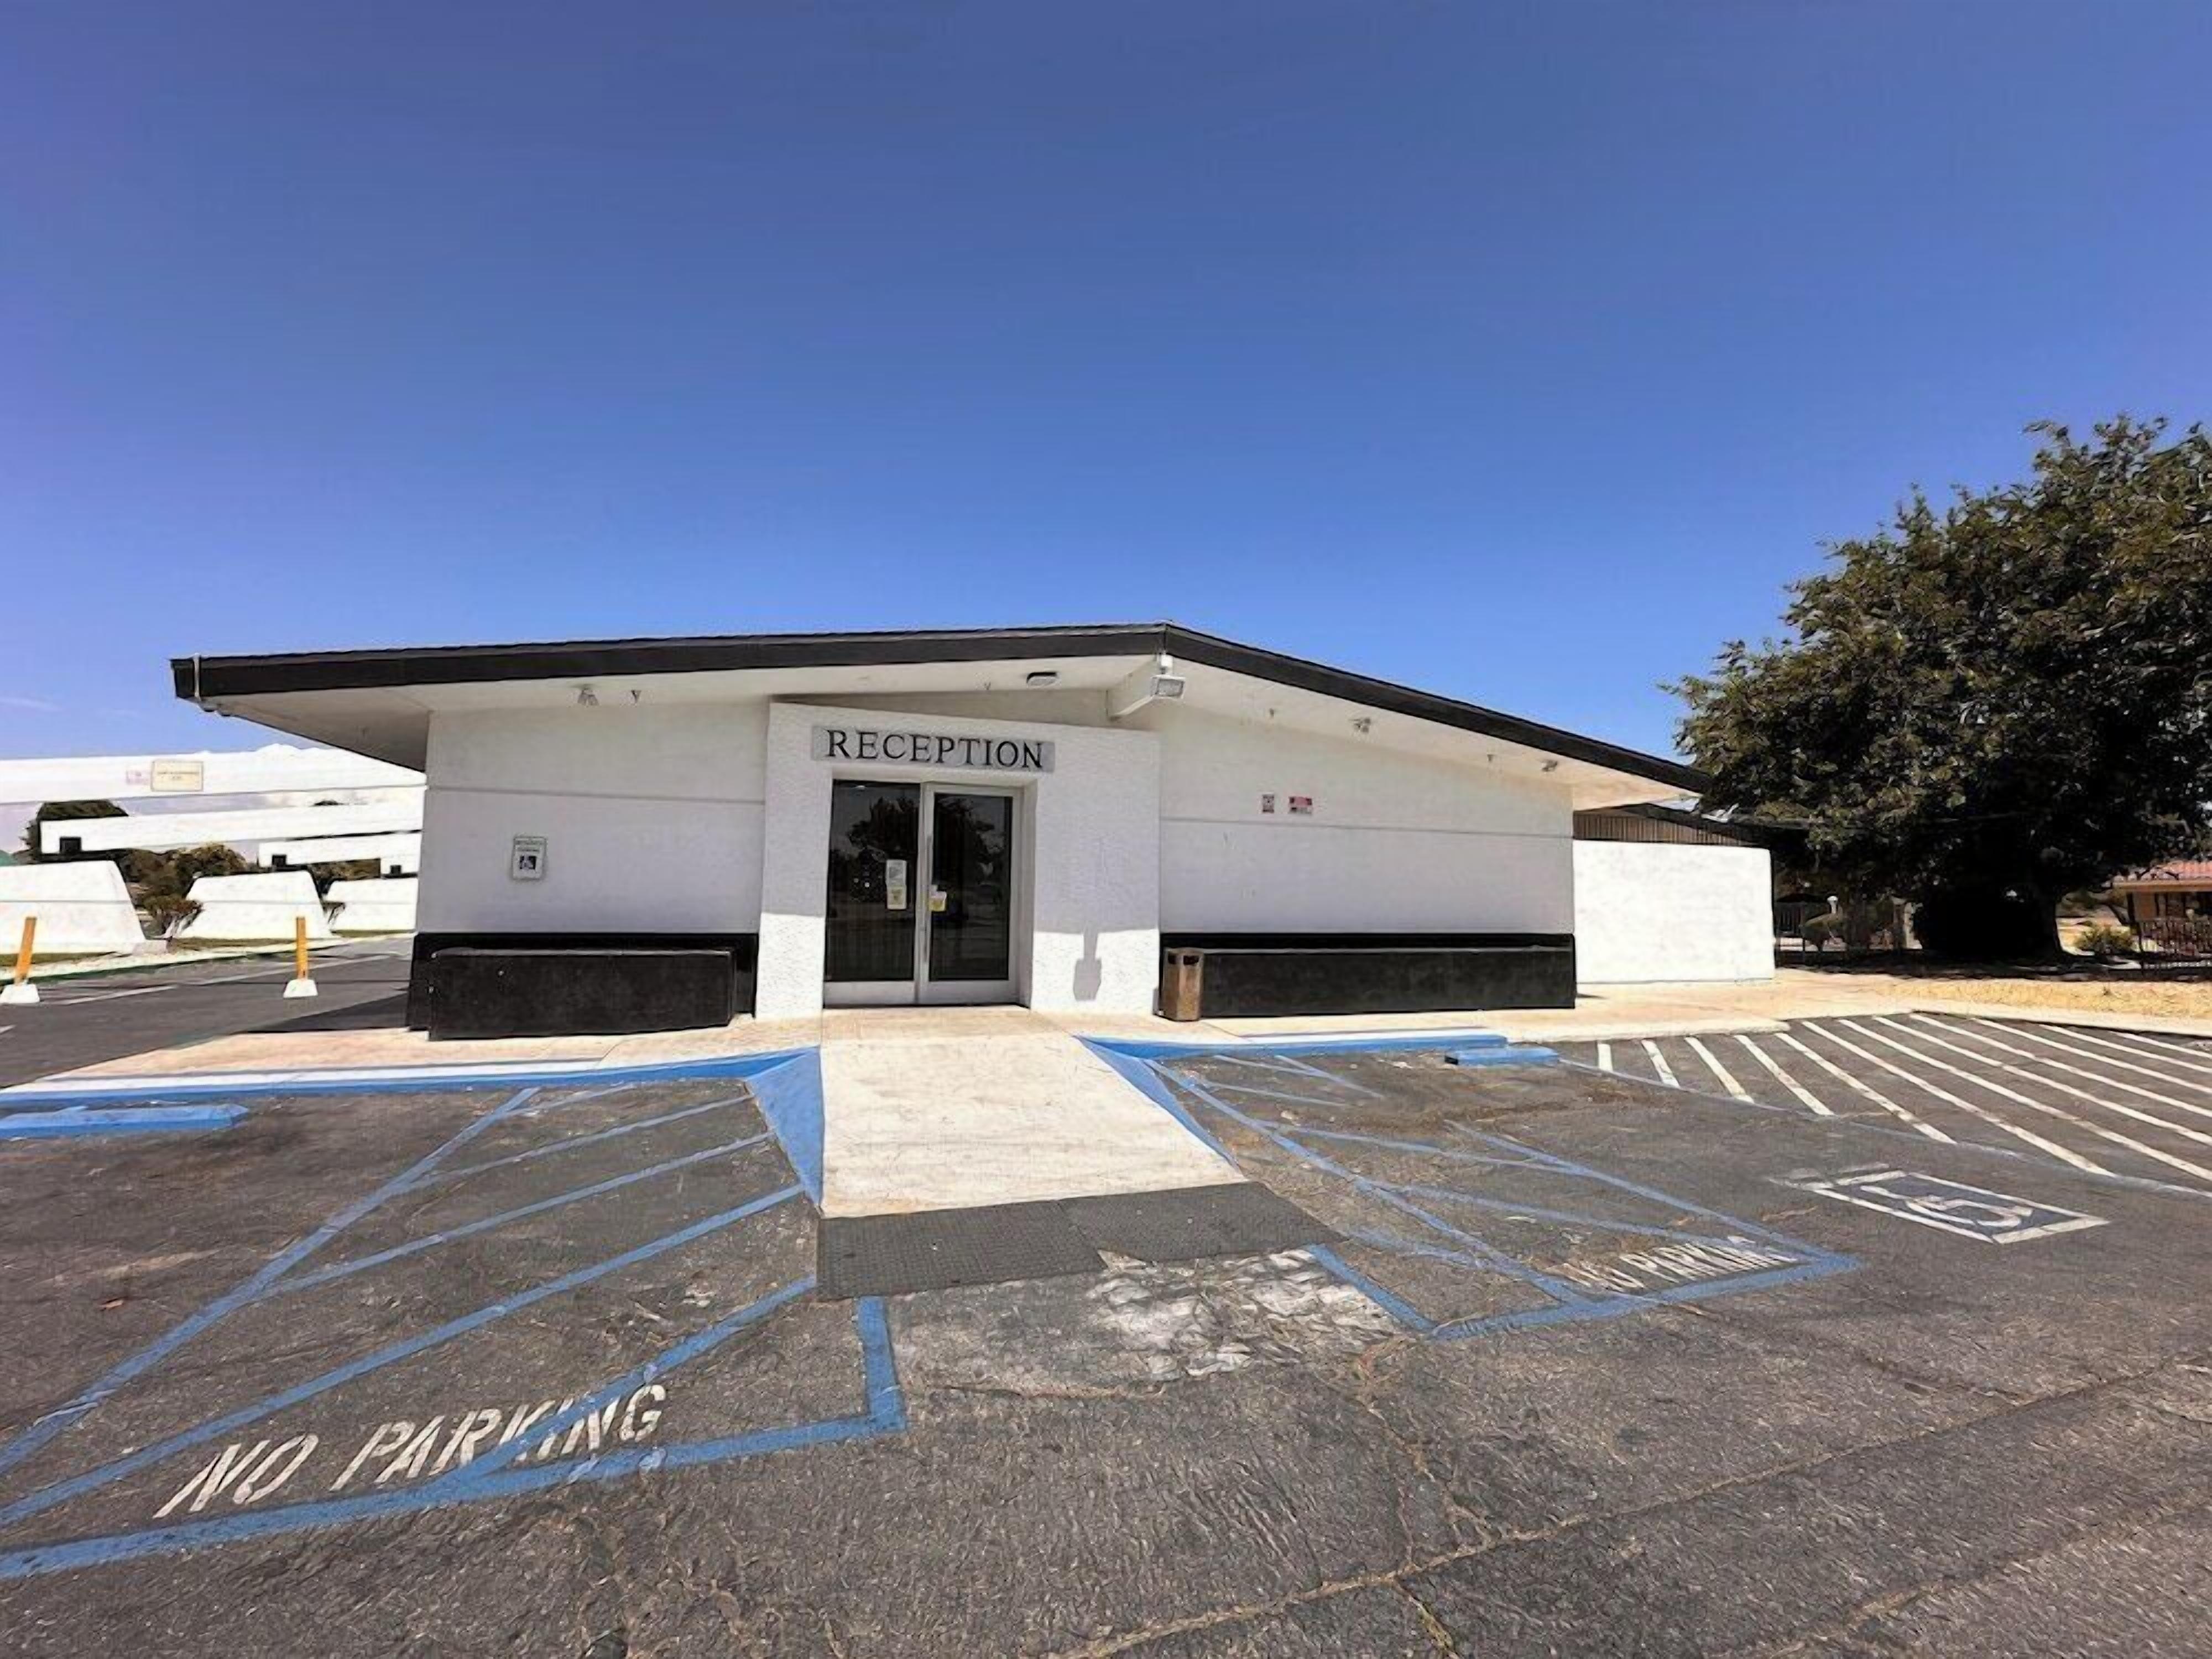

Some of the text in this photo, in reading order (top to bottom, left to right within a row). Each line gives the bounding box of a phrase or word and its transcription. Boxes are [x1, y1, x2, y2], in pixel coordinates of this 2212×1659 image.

[826, 729, 1043, 769] RECEPTION
[153, 1385, 667, 1519] NO PARKING
